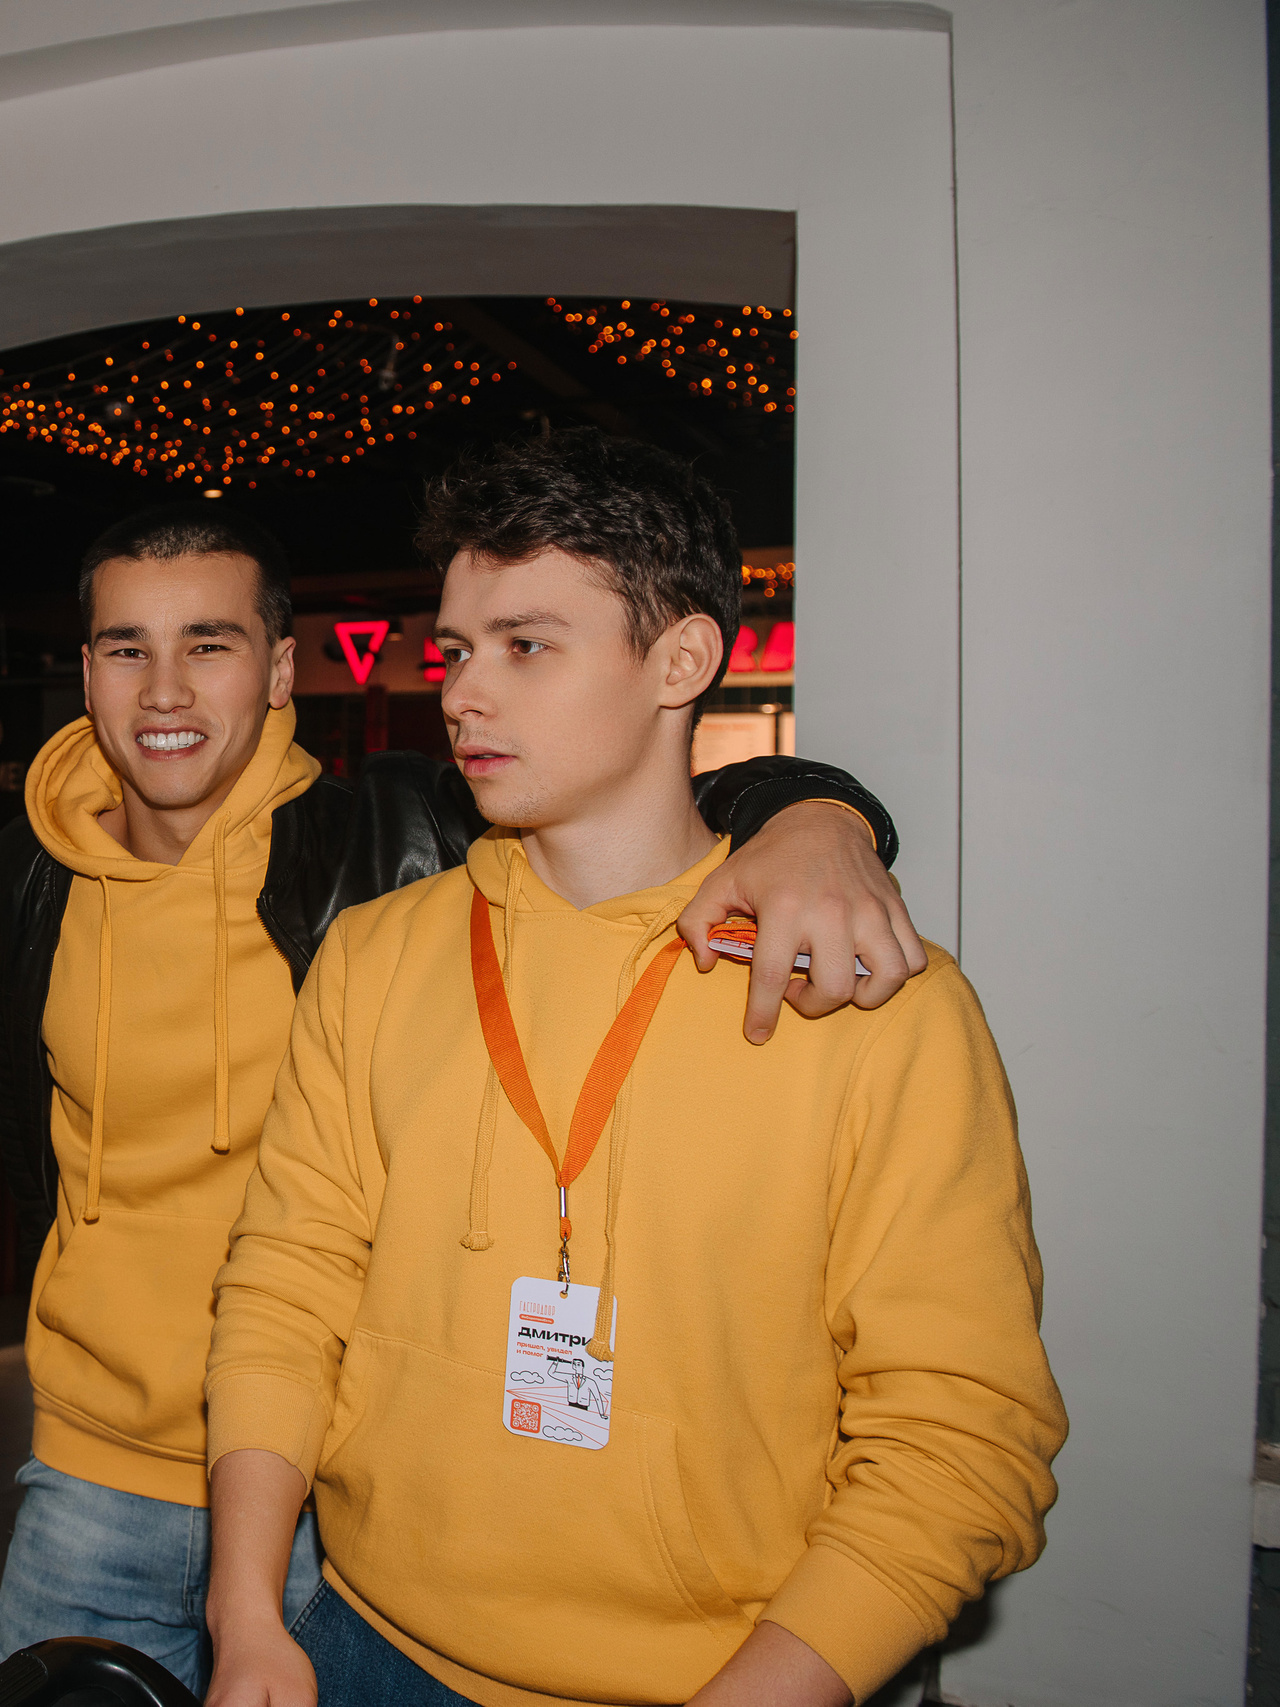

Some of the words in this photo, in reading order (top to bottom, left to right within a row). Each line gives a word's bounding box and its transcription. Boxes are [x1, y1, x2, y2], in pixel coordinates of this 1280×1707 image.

[518, 1326, 592, 1347] дмитри
[522, 1350, 544, 1358] помог
[547, 1346, 573, 1356] увидел
